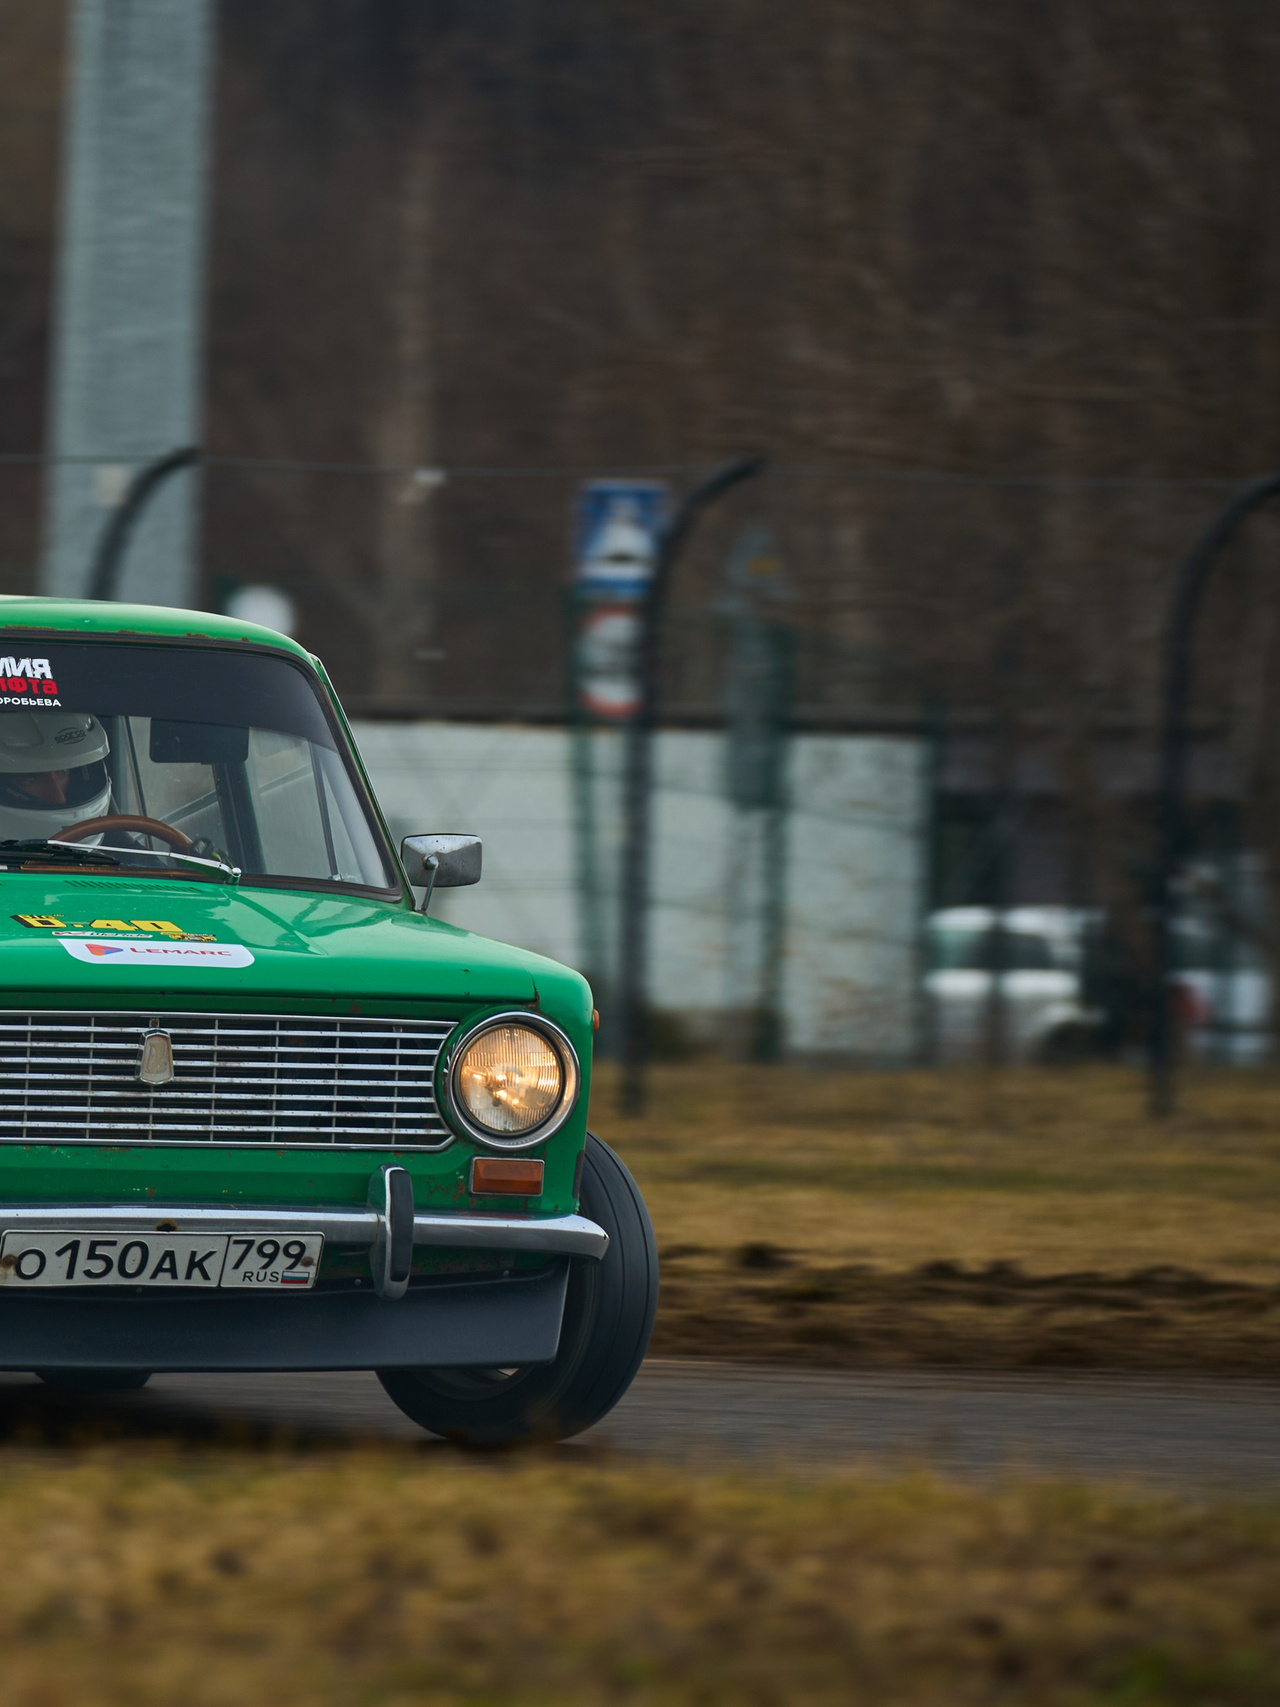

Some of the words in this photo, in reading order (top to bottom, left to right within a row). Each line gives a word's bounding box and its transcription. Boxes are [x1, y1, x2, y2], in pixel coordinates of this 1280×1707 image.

[130, 947, 232, 956] LEMARC
[232, 1239, 306, 1272] 799
[242, 1271, 280, 1283] RUS
